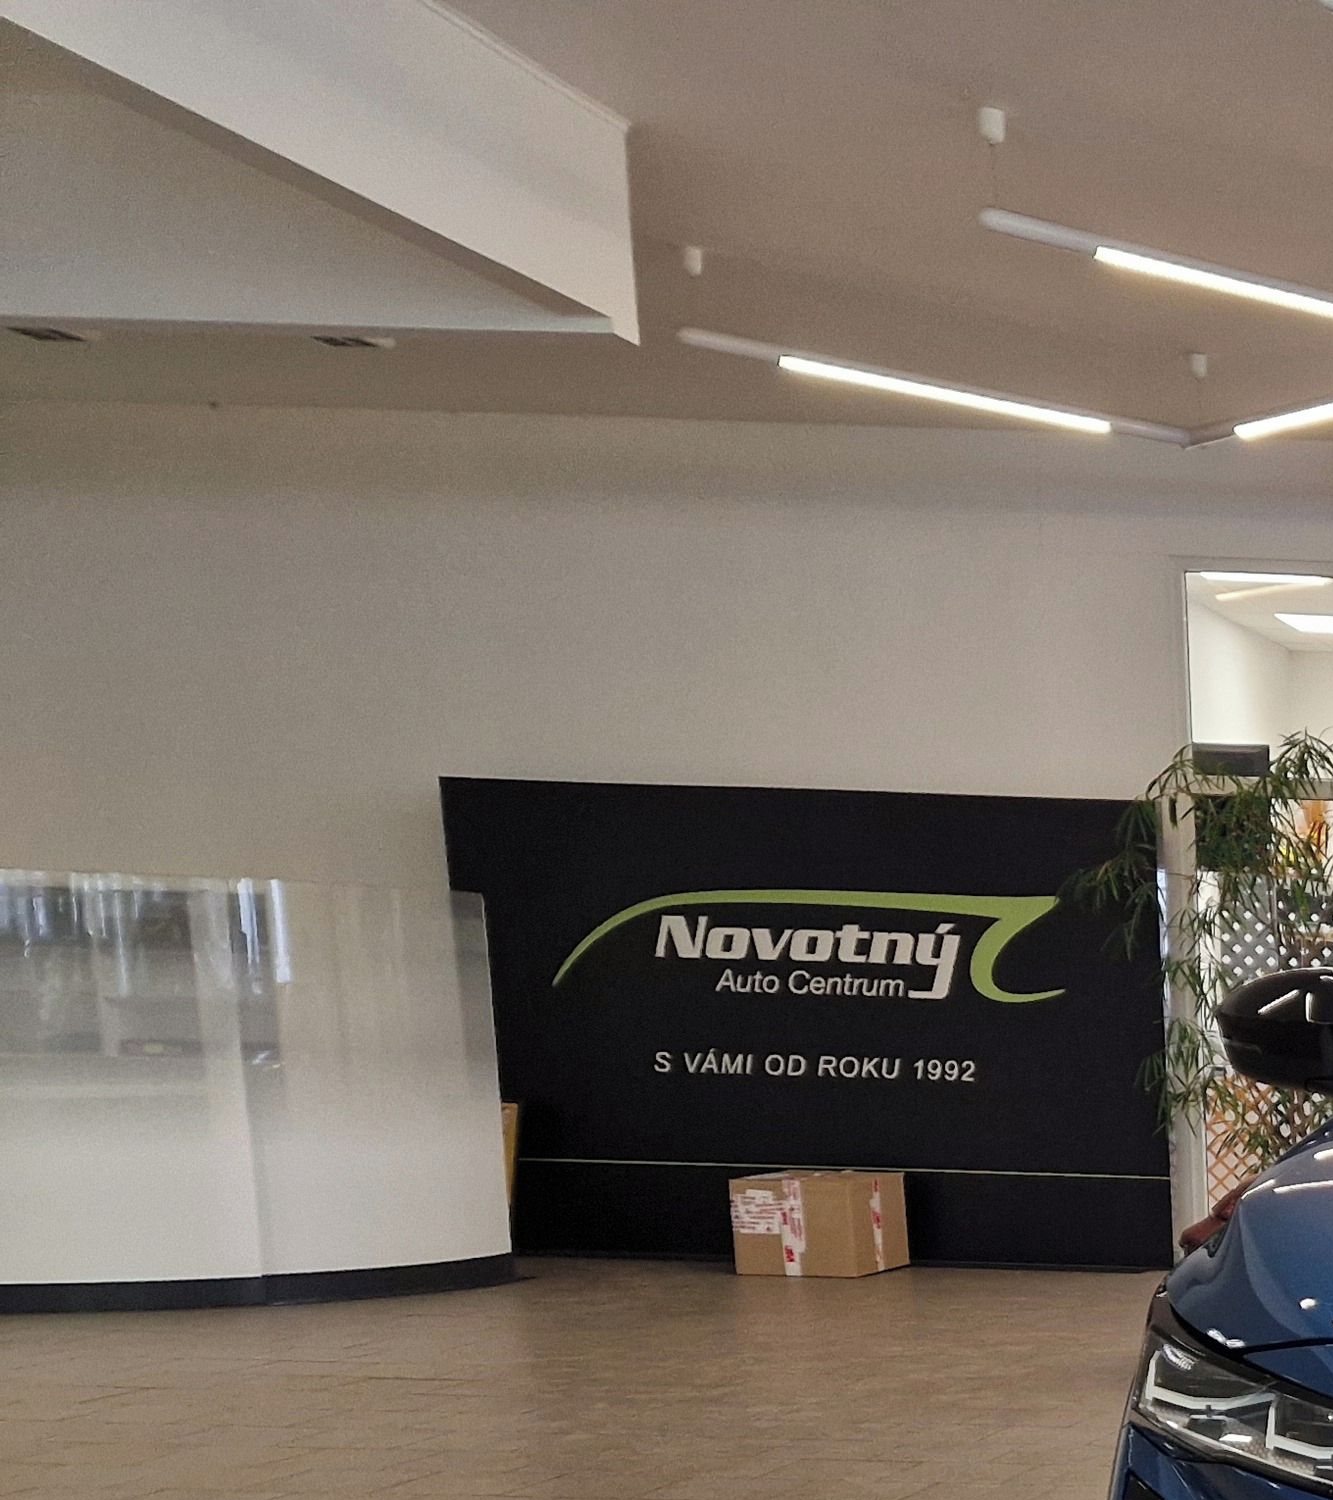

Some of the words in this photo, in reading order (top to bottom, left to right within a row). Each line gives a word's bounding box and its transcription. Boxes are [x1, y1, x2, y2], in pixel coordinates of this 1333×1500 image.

[655, 915, 961, 1000] Novotný
[715, 968, 780, 994] Auto
[788, 970, 905, 997] Centrum
[653, 1051, 671, 1073] S
[684, 1049, 752, 1075] VÁMI
[764, 1053, 806, 1077] OD
[817, 1056, 900, 1080] ROKU
[913, 1058, 976, 1081] 1992
